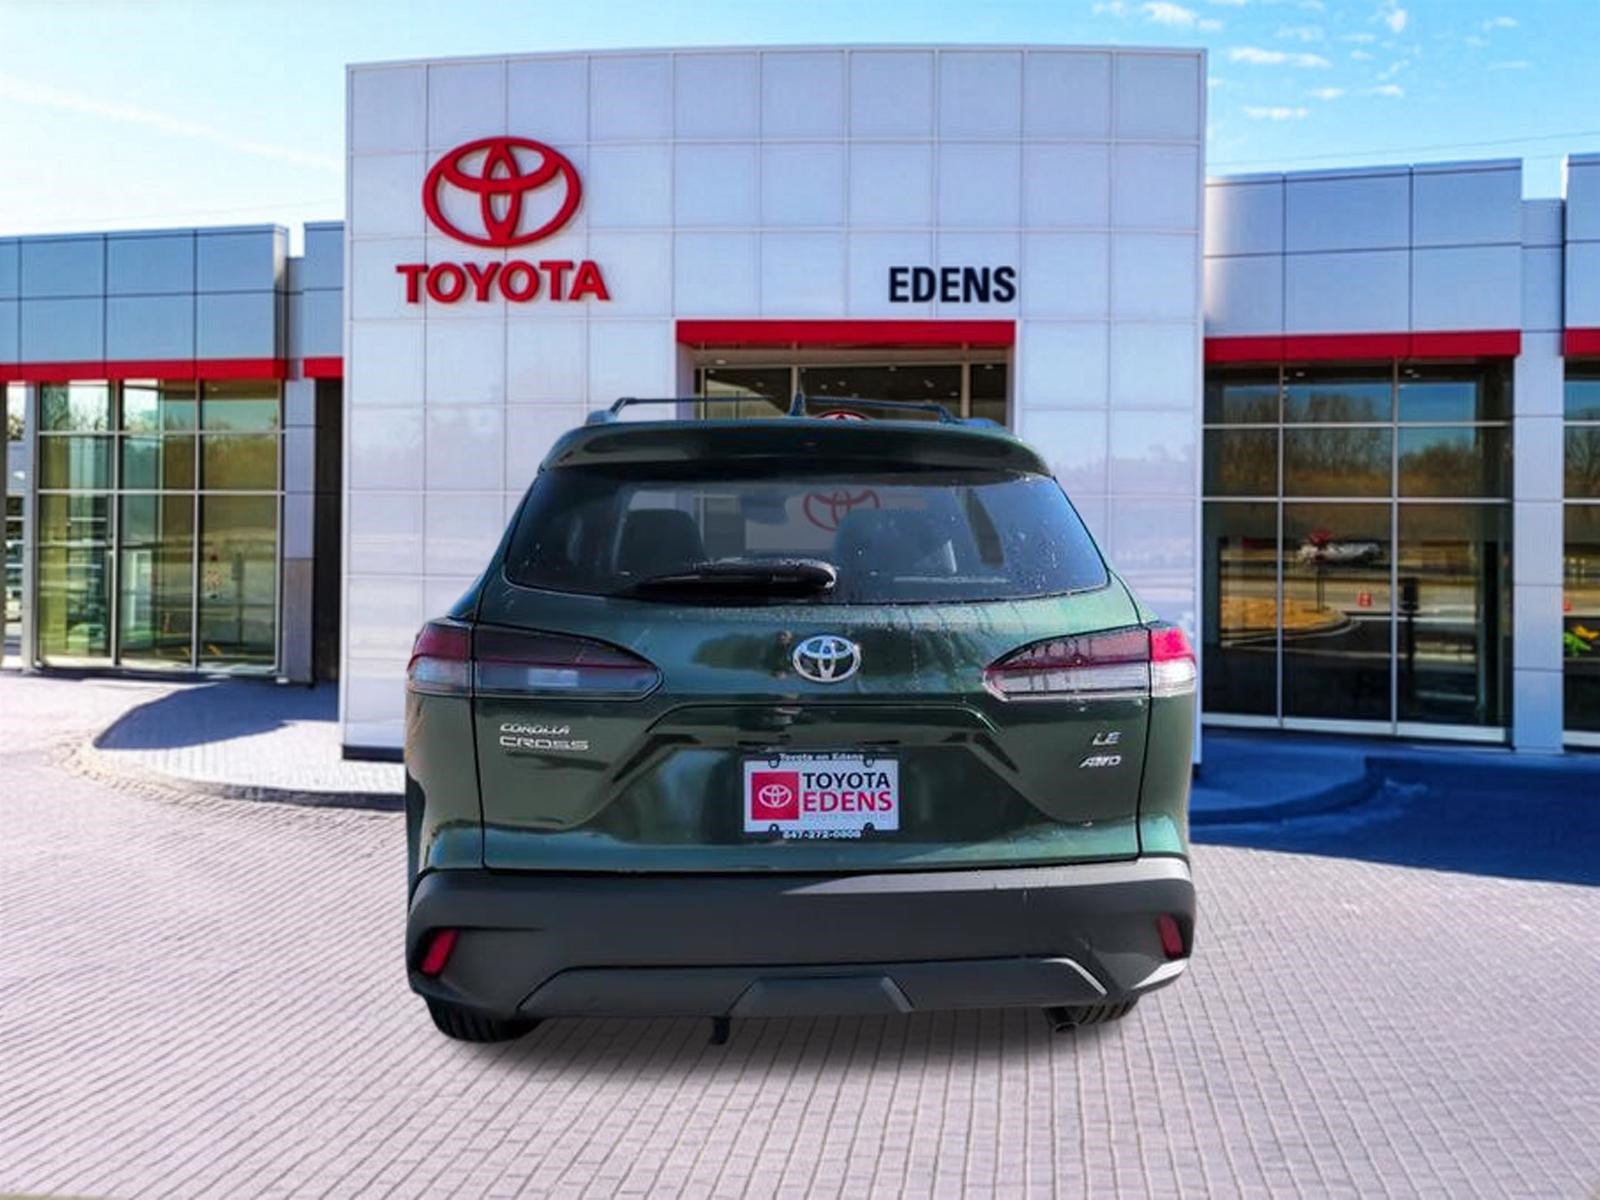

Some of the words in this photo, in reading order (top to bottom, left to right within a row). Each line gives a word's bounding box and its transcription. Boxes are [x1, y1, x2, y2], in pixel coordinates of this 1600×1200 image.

[396, 260, 610, 303] TOYOTA
[889, 266, 1016, 303] EDENS
[500, 723, 570, 734] COROLLA
[500, 736, 588, 750] CROSS
[1092, 731, 1121, 745] LE
[1079, 755, 1121, 768] AWD
[802, 772, 891, 789] TOYOTA
[803, 791, 893, 812] EDENS
